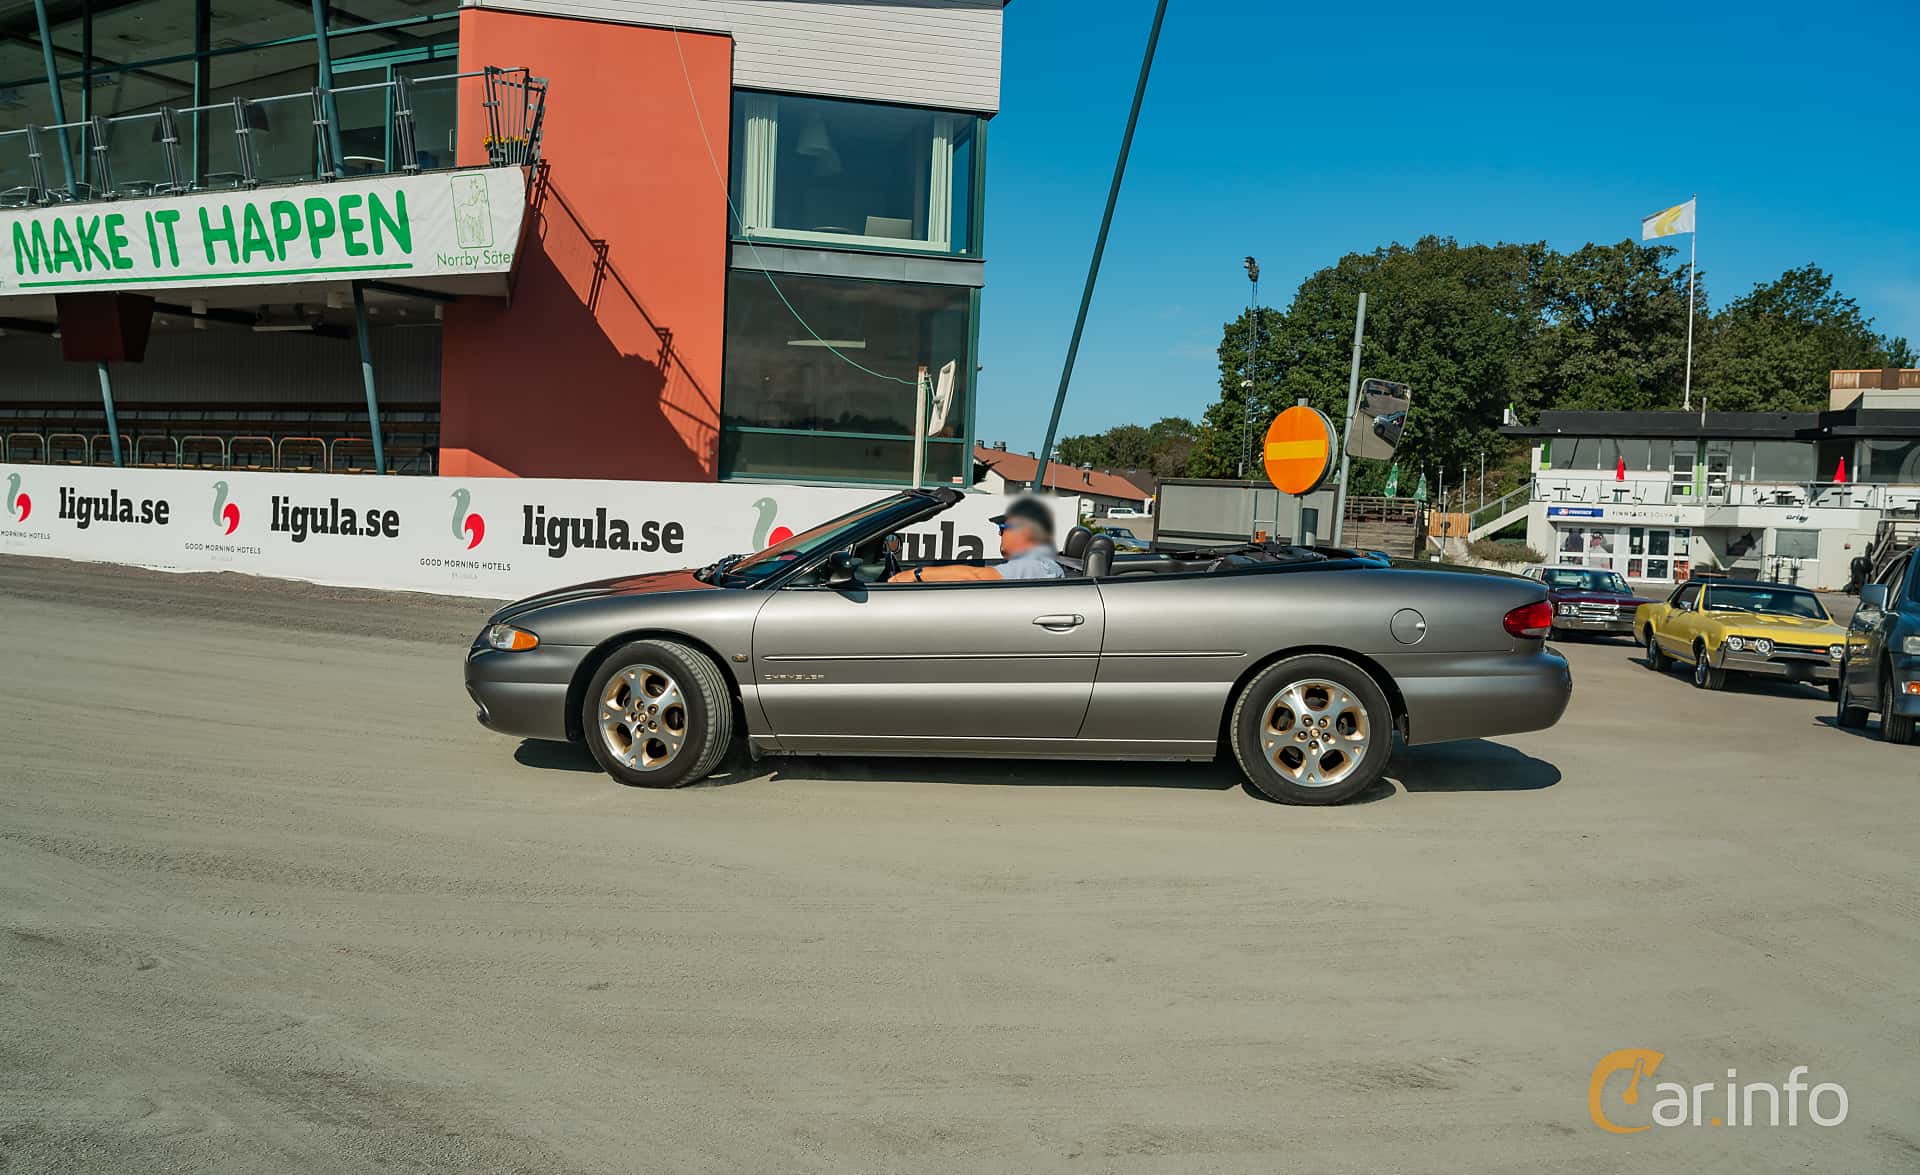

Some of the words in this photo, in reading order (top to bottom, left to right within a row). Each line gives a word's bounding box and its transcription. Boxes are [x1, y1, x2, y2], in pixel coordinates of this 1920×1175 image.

[12, 213, 134, 275] MAKE
[145, 209, 180, 269] IT
[198, 189, 413, 266] HAPPEN
[436, 250, 480, 270] Norrby
[59, 487, 170, 529] ligula.se
[270, 496, 400, 542] ligula.se
[184, 542, 204, 551] GOOD
[205, 543, 235, 553] MORNING
[236, 546, 262, 555] HOTELS
[522, 504, 684, 558] ligula.se
[419, 558, 441, 567] GOOD
[444, 559, 480, 569] MORNING
[482, 561, 512, 571] HOTELS
